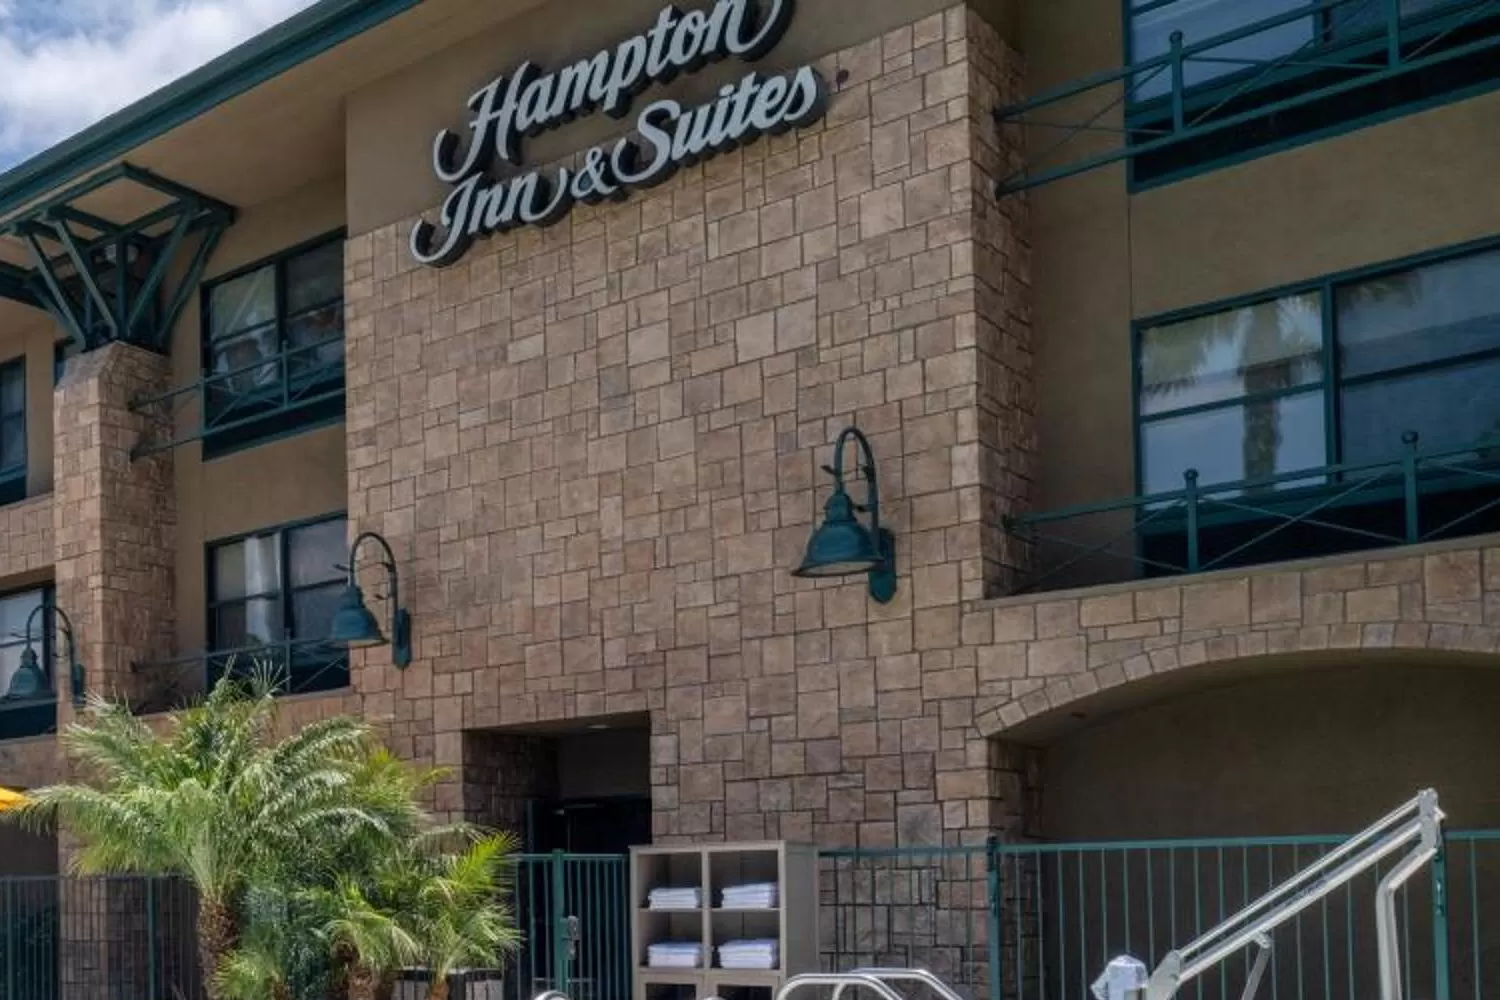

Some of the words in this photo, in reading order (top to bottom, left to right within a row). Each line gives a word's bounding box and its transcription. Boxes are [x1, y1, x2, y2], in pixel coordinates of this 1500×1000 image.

[410, 167, 567, 264] Inn
[571, 147, 618, 198] &
[611, 65, 818, 184] Suites
[433, 0, 784, 183] Hampton
